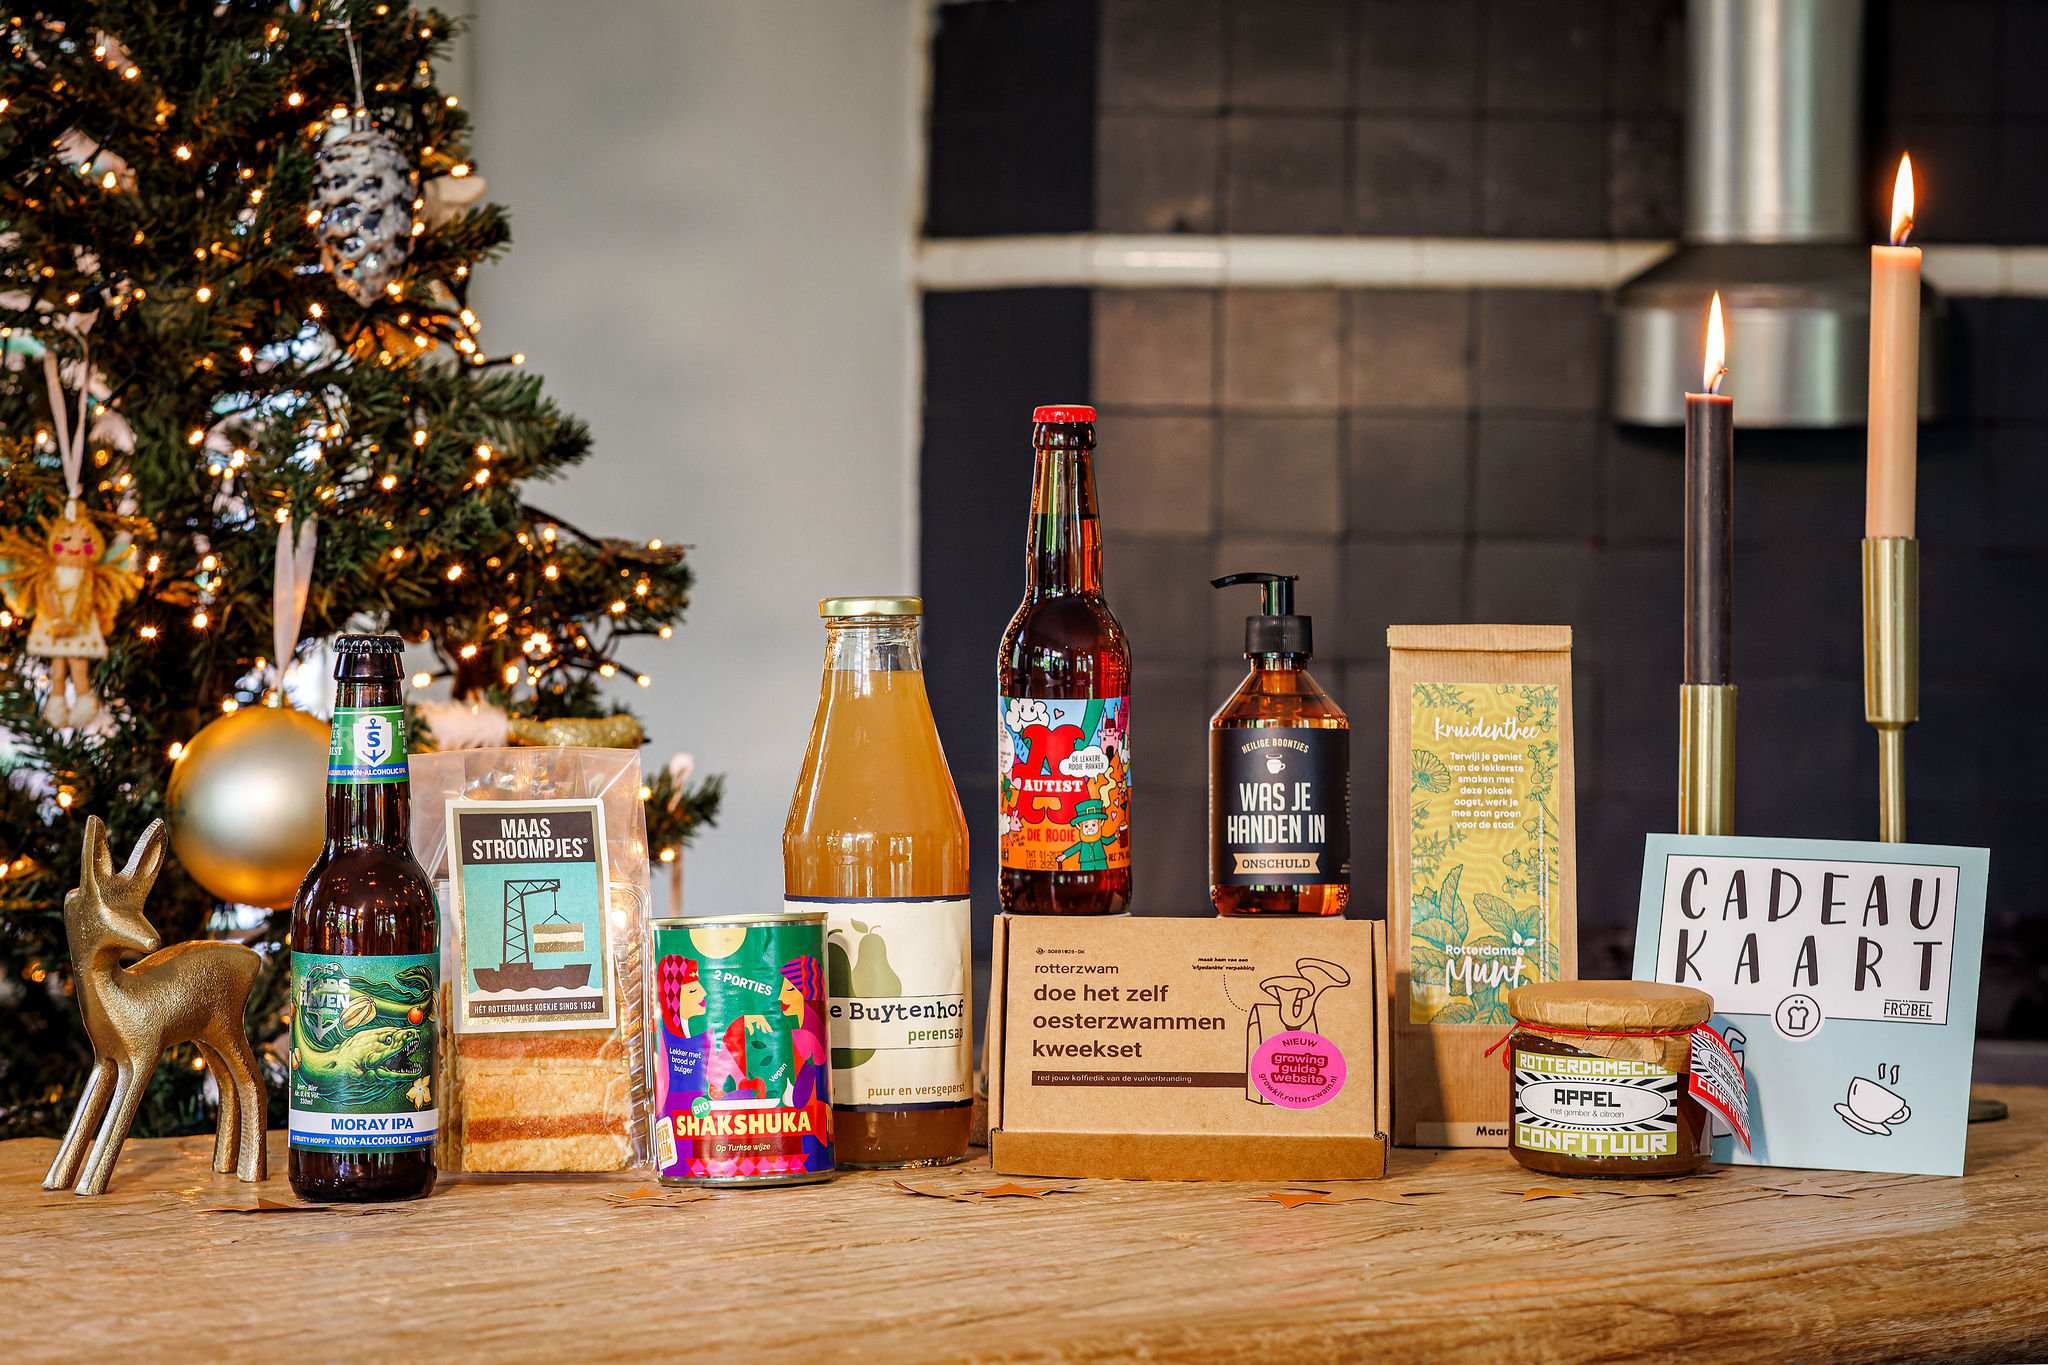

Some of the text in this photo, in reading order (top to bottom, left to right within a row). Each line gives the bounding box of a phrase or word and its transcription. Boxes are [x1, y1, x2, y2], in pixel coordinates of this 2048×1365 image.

[1241, 738, 1310, 754] HEILIGE BOONTJES
[1071, 755, 1101, 763] DE LEKKERE
[1450, 752, 1522, 763] Terwijl je geniet
[347, 767, 399, 776] NON-ALCOHOLIC
[1068, 762, 1104, 771] ROOIE RAKKER
[1468, 764, 1479, 772] de
[1481, 764, 1525, 772] lekkerste
[1023, 779, 1083, 792] AUTIST
[1458, 775, 1515, 784] smaken met
[1239, 782, 1285, 811] WAS
[1291, 782, 1311, 811] JE
[1460, 787, 1513, 795] deze lokale
[1454, 799, 1484, 807] oogst,
[1509, 799, 1519, 807] je
[1494, 811, 1521, 819] groen
[500, 818, 552, 838] MAAS
[1227, 814, 1326, 844] HANDEN IN
[1479, 821, 1491, 829] de
[1493, 821, 1517, 829] stad.
[1027, 828, 1041, 842] DIE
[1046, 828, 1076, 842] ROOIE
[1242, 859, 1311, 869] ONSCHULD
[1680, 867, 1941, 931] CADEAU
[1445, 944, 1526, 956] Rotterdamse
[1675, 928, 1943, 992] KAART
[1034, 963, 1119, 974] rotterzwam
[301, 977, 350, 993] STADS
[713, 970, 773, 996] 2 PORTIES
[300, 991, 350, 1008] HAVEN
[1033, 984, 1169, 1002] doe het zelf
[488, 1003, 533, 1014] ROTTERDAMSE
[534, 1001, 558, 1011] KOEKJE
[559, 1000, 578, 1010] SINDS
[849, 999, 964, 1023] Buytenhof
[1033, 1014, 1226, 1030] oesterzwammen
[908, 1028, 964, 1045] perensap
[1282, 1037, 1318, 1048] NIEUW
[669, 1047, 702, 1059] Lekker met
[1032, 1039, 1143, 1058] kweekset
[671, 1055, 696, 1067] brood of
[1274, 1054, 1326, 1066] growing
[768, 1062, 788, 1084] Vegan
[1281, 1063, 1317, 1074] guide
[1051, 1075, 1070, 1083] jouw
[1133, 1075, 1192, 1083] vuilverbranding
[1273, 1073, 1324, 1084] website
[868, 1082, 965, 1098] puur en versgeperst
[1258, 1073, 1339, 1103] growkit.rotterzwam.nl
[1553, 1089, 1622, 1108] APPEL
[693, 1101, 710, 1116] BIO
[1550, 1108, 1625, 1119] met gember & citroen
[331, 1117, 414, 1131] MORAY IPA
[676, 1111, 811, 1137] SHAKSHUKA
[310, 1136, 331, 1144] HOPPY
[334, 1135, 412, 1146] NON-ALCOHOLIC
[1519, 1127, 1668, 1154] CONFITUUR
[715, 1143, 771, 1152] Op Turkse wijze
